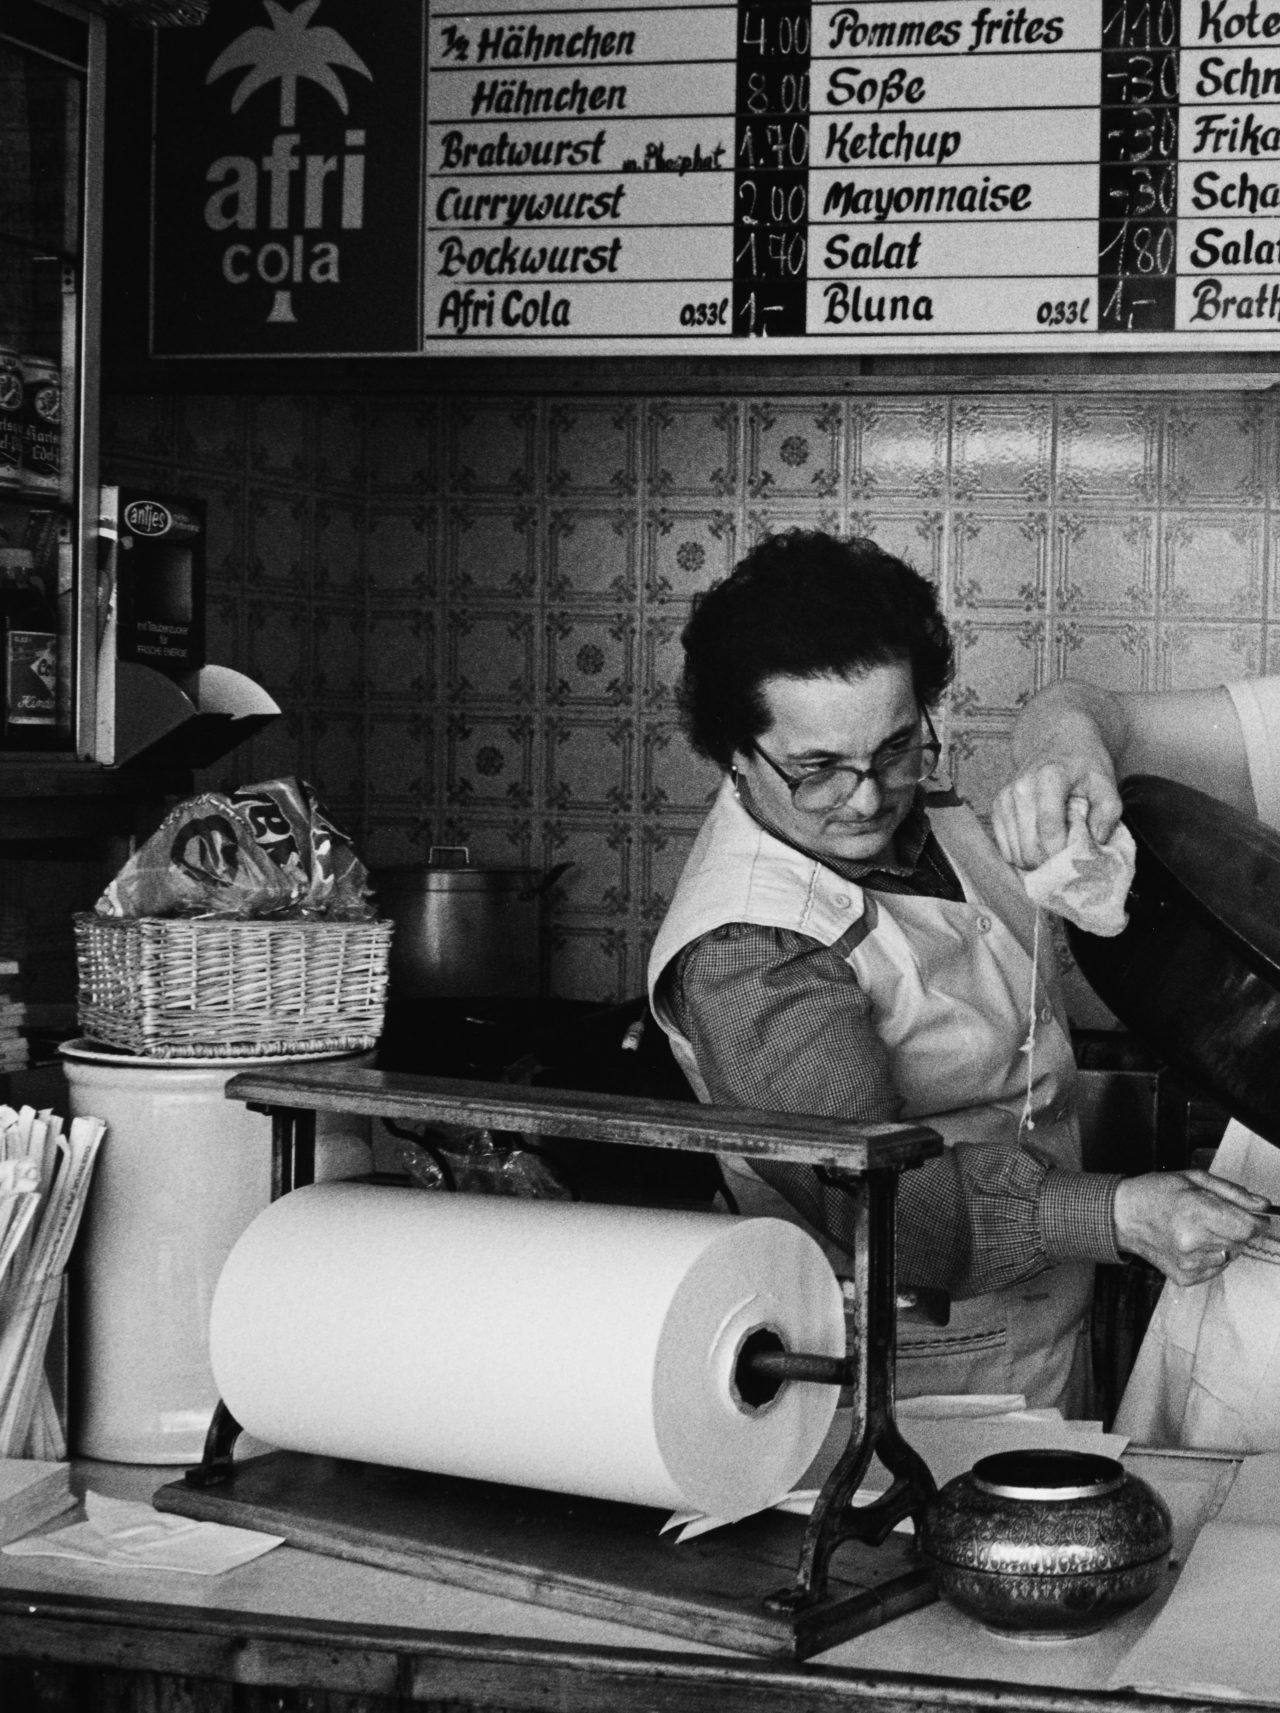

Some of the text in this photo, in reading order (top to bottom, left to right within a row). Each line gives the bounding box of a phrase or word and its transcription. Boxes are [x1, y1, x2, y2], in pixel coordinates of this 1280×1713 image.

[477, 25, 636, 62] Hähnchen
[743, 12, 810, 56] 4.00
[829, 3, 1064, 52] Pommes frites
[471, 79, 627, 116] Hähnchen
[827, 66, 926, 110] Soße
[440, 130, 605, 170] Bratwurst
[826, 122, 962, 166] Ketchup
[203, 130, 364, 230] afri
[823, 176, 1032, 222] Mayonnaise
[435, 183, 626, 226] Currywurst
[222, 235, 341, 284] cola
[437, 235, 622, 277] Bockwurst
[823, 232, 922, 270] Salat
[437, 290, 495, 334] Afri
[502, 290, 571, 328] Cola
[823, 284, 935, 324] Bluna
